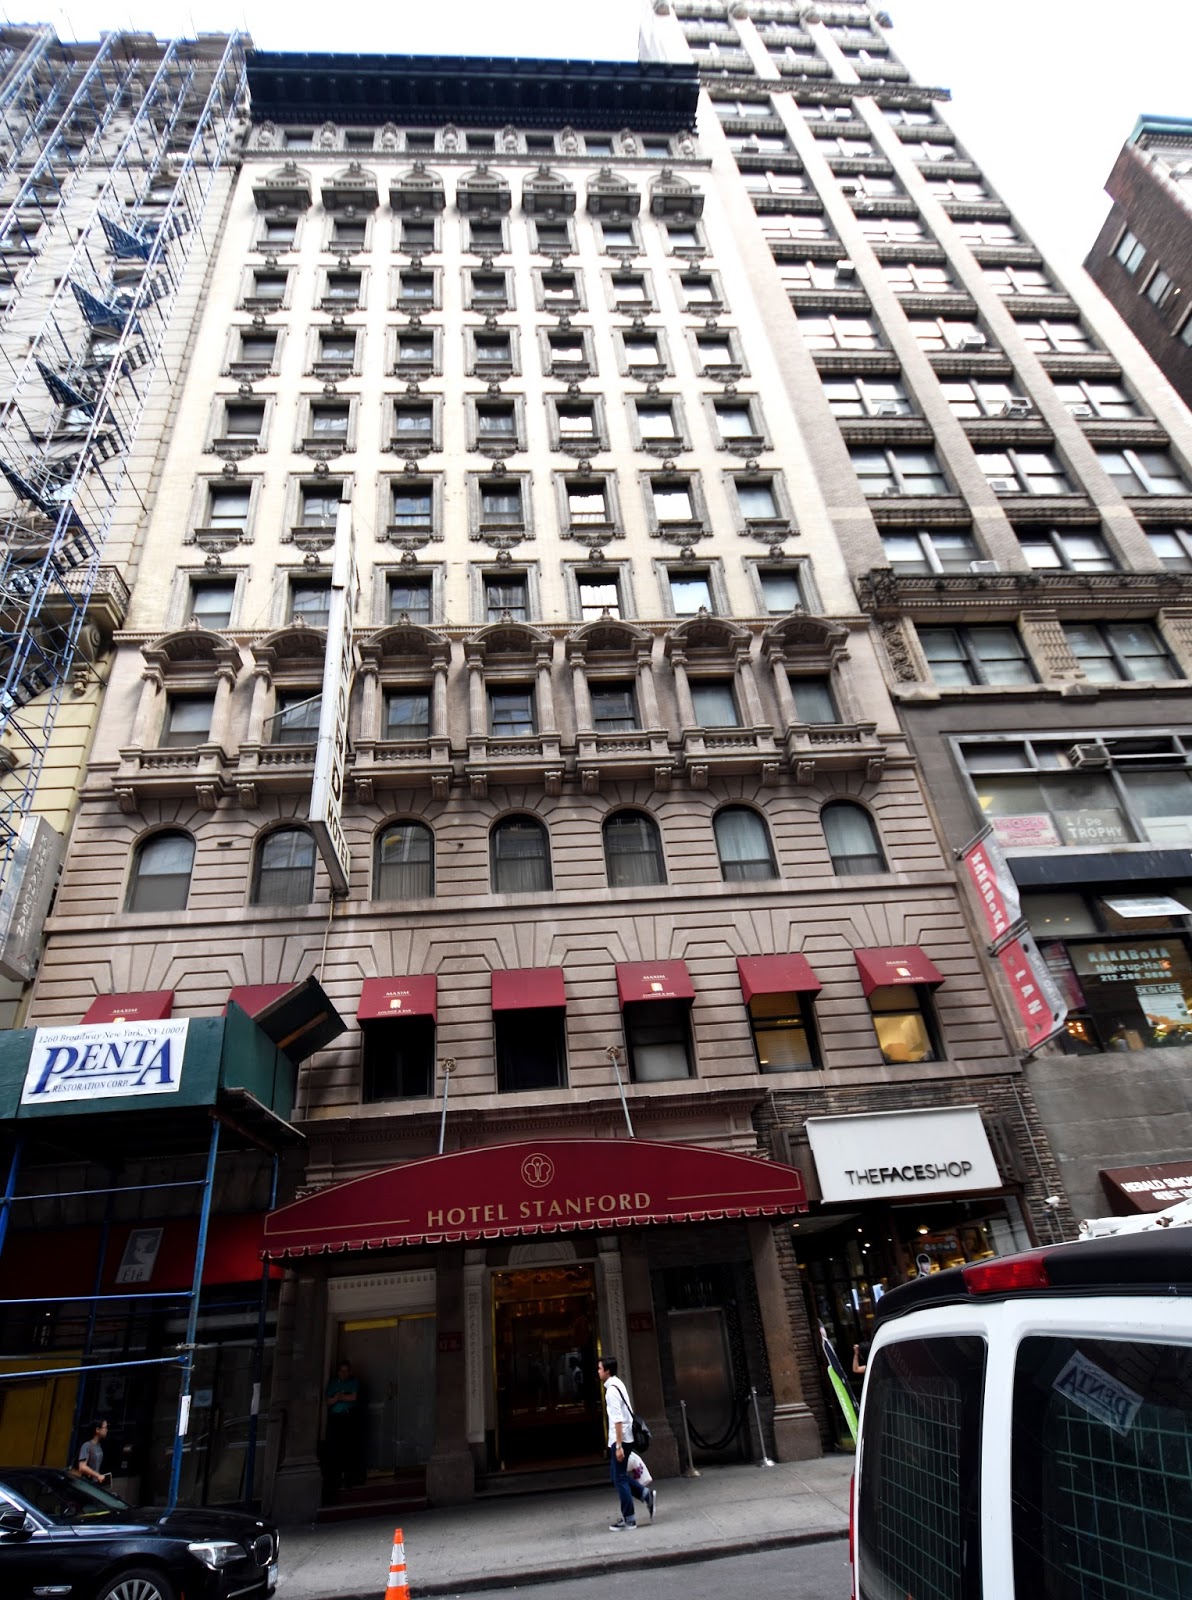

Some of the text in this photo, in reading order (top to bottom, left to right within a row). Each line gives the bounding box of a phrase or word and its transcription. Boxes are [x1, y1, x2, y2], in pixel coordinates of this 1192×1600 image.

[326, 799, 350, 878] HOTEL
[1067, 827, 1123, 839] TROPHY
[1015, 968, 1043, 1015] LAN
[1135, 984, 1181, 995] SKIN CARE
[38, 1026, 185, 1043] 1260 Broadway New York, NY 10001
[28, 1037, 174, 1095] PENTA
[51, 1079, 129, 1093] RESTORATION CORP.
[1120, 1179, 1168, 1193] HERALD
[427, 1192, 652, 1228] HOTEL STANFORD
